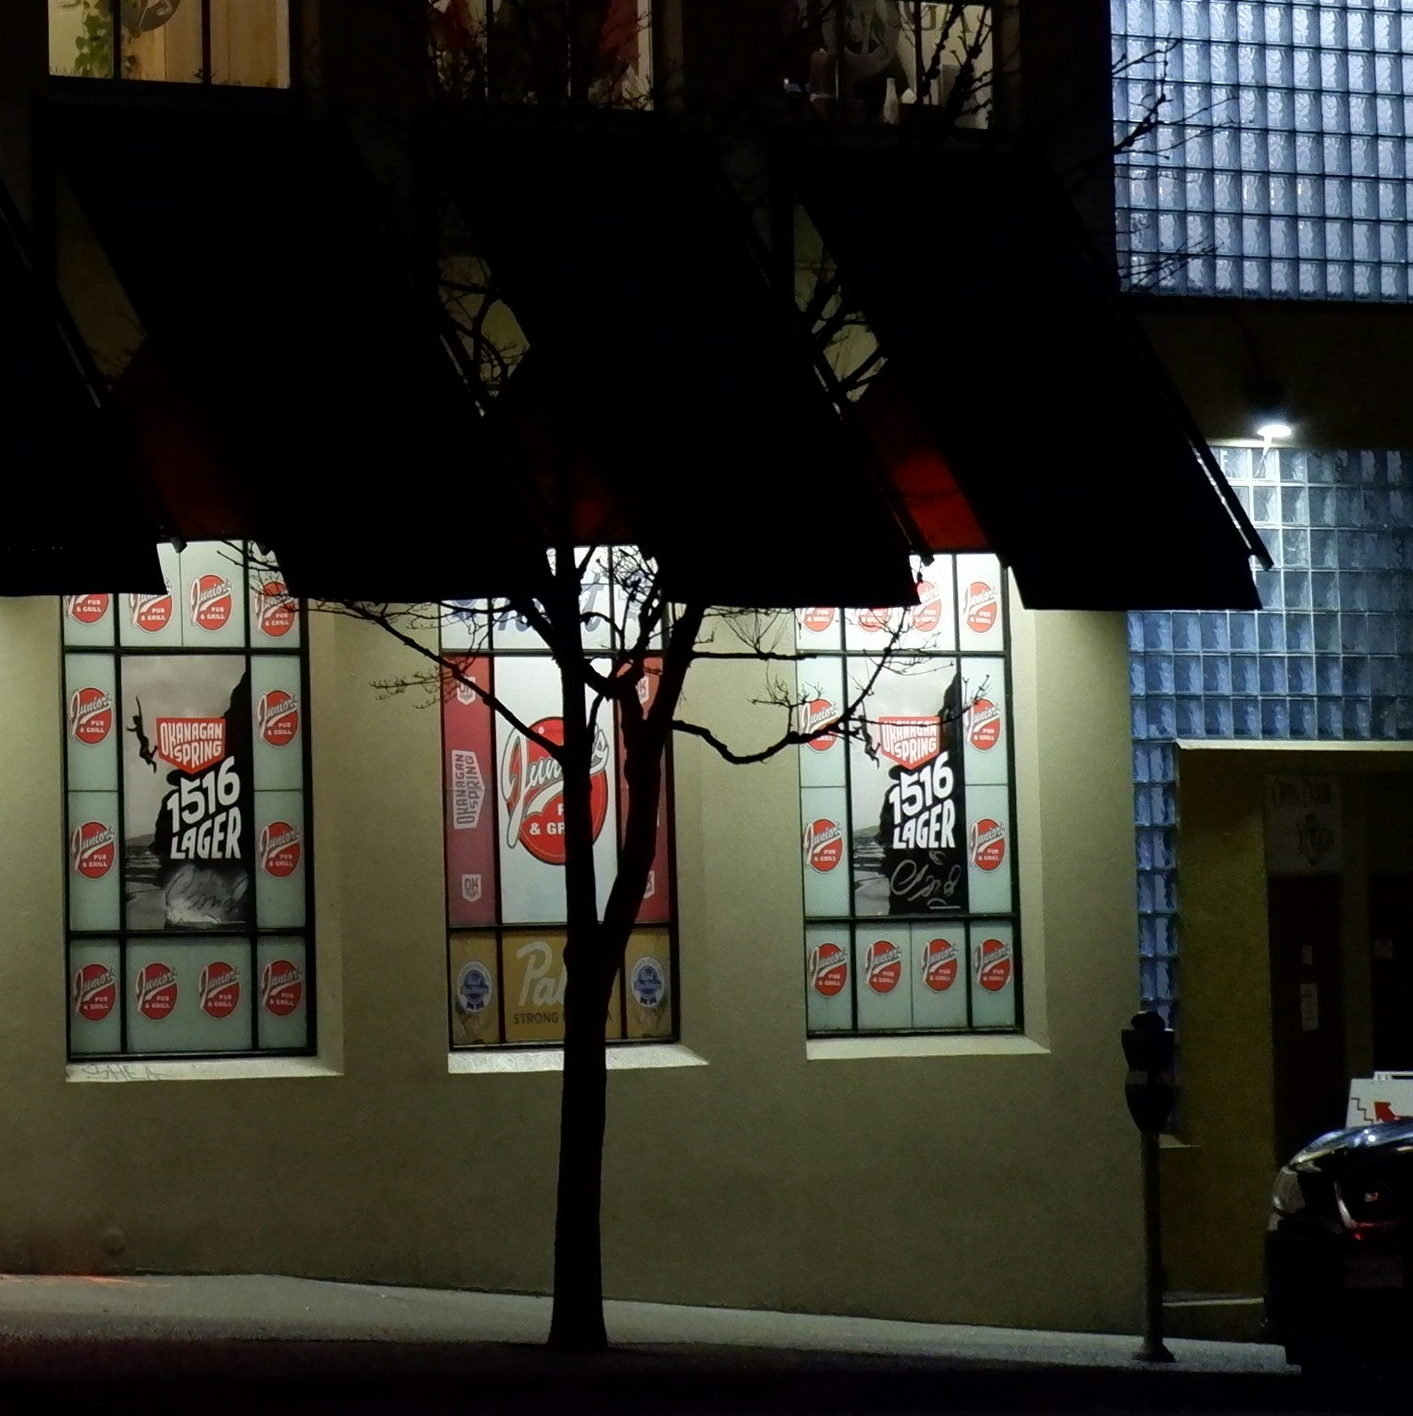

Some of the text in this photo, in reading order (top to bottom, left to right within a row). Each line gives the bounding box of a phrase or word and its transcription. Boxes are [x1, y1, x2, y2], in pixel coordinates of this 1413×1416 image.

[160, 722, 223, 758] OKANAGAN
[173, 741, 222, 769] SPRING
[894, 737, 937, 765] SPRING
[166, 755, 241, 834] 1516
[889, 750, 954, 825] 1516
[170, 806, 242, 860] LAGER
[530, 822, 541, 836] &
[893, 798, 956, 850] LAGER
[513, 1011, 559, 1025] STRONG
